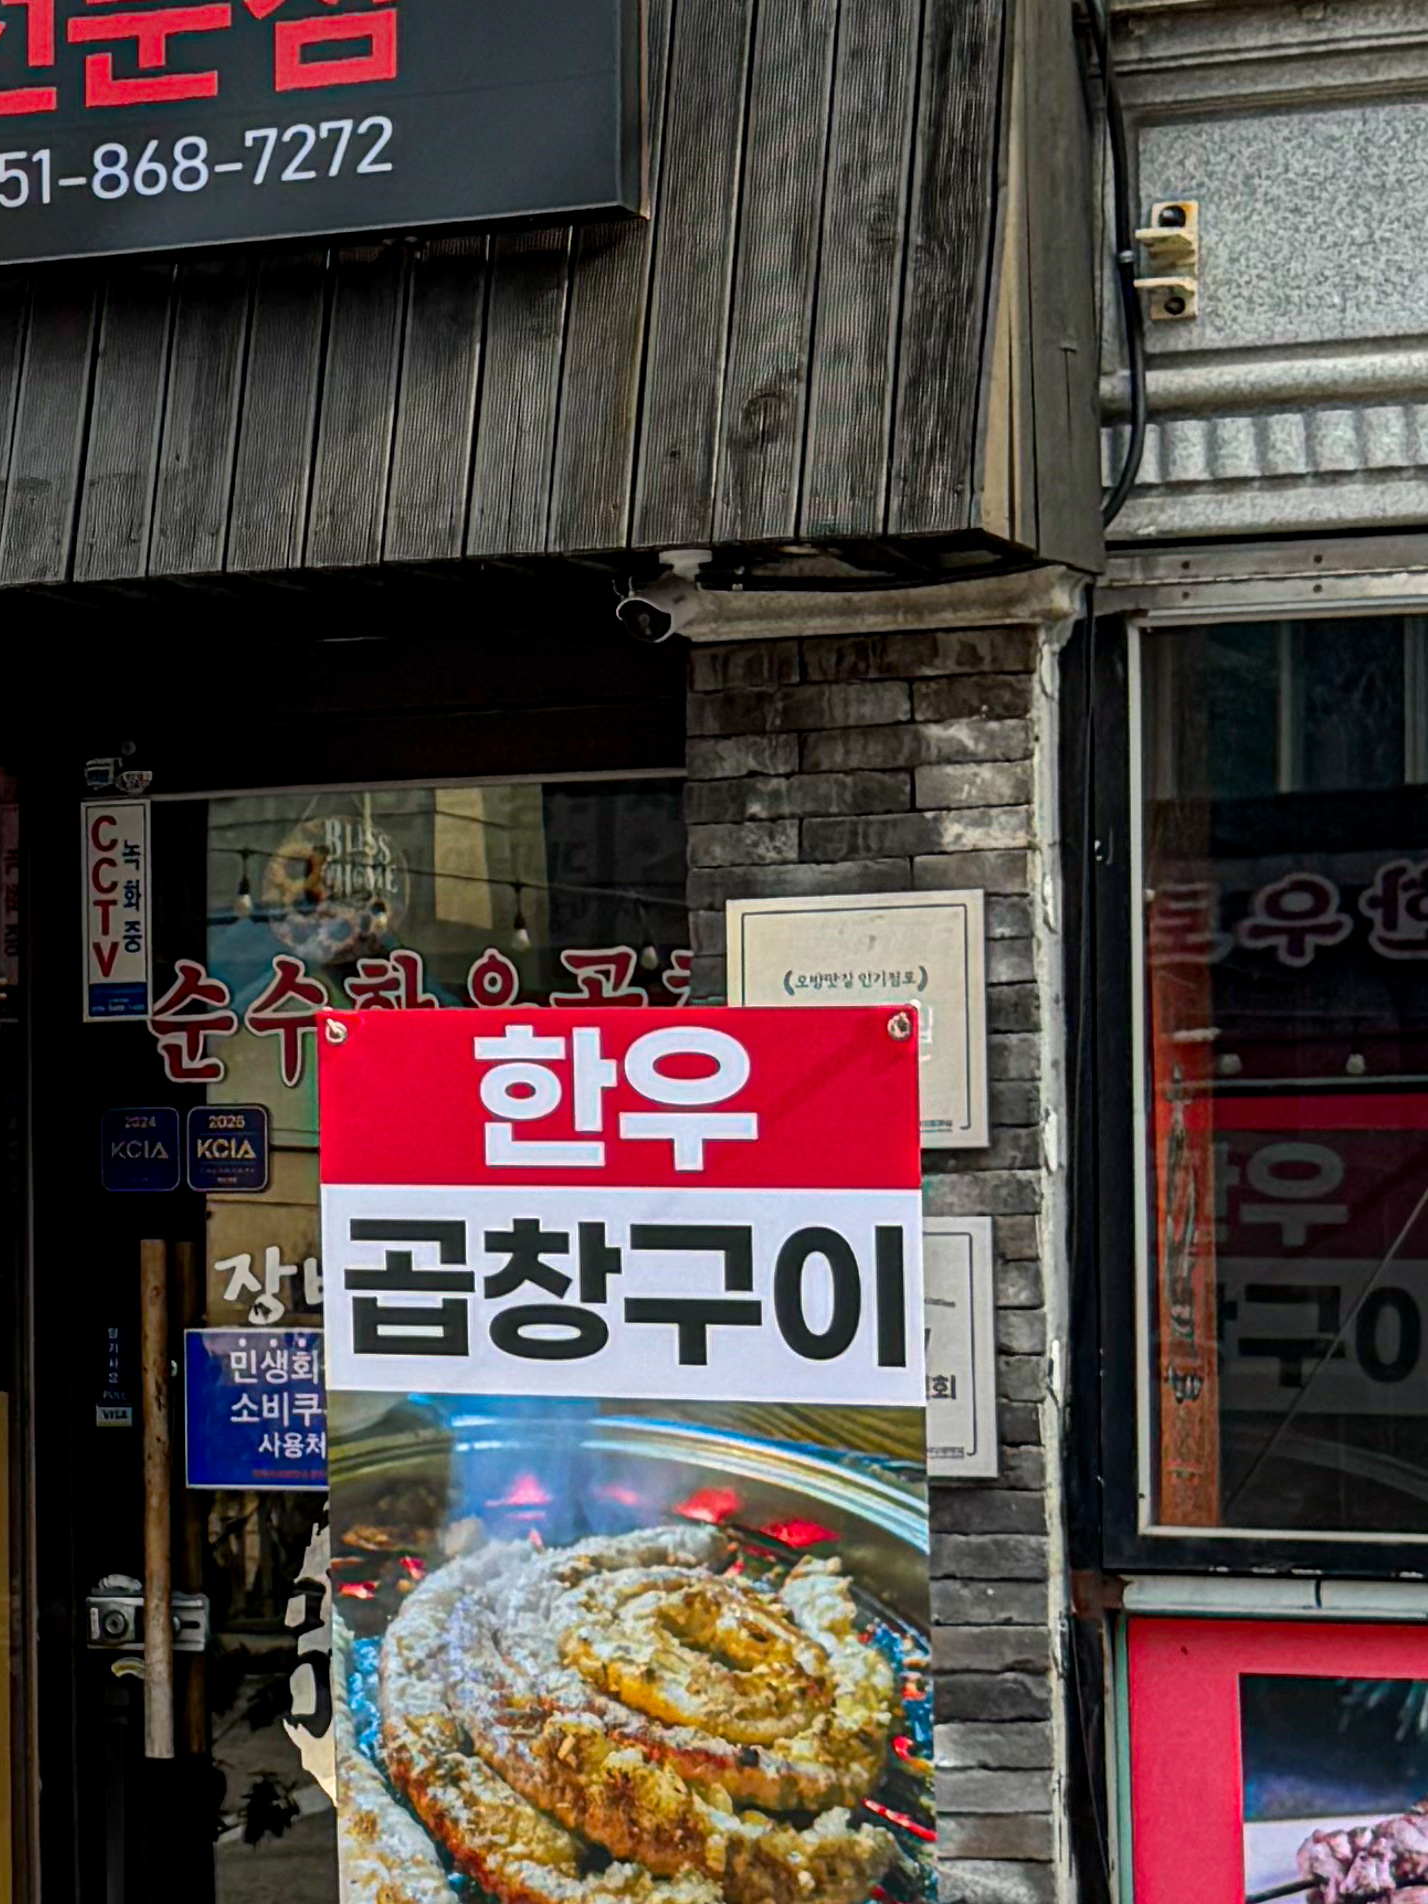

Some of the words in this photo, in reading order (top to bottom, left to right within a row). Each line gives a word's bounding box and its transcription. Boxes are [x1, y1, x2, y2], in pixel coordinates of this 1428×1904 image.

[91, 815, 118, 977] CCTV
[111, 1141, 168, 1159] KCIA
[197, 1138, 256, 1159] KCIA
[473, 1024, 759, 1172] 한우
[343, 1217, 907, 1369] 곱창구이
